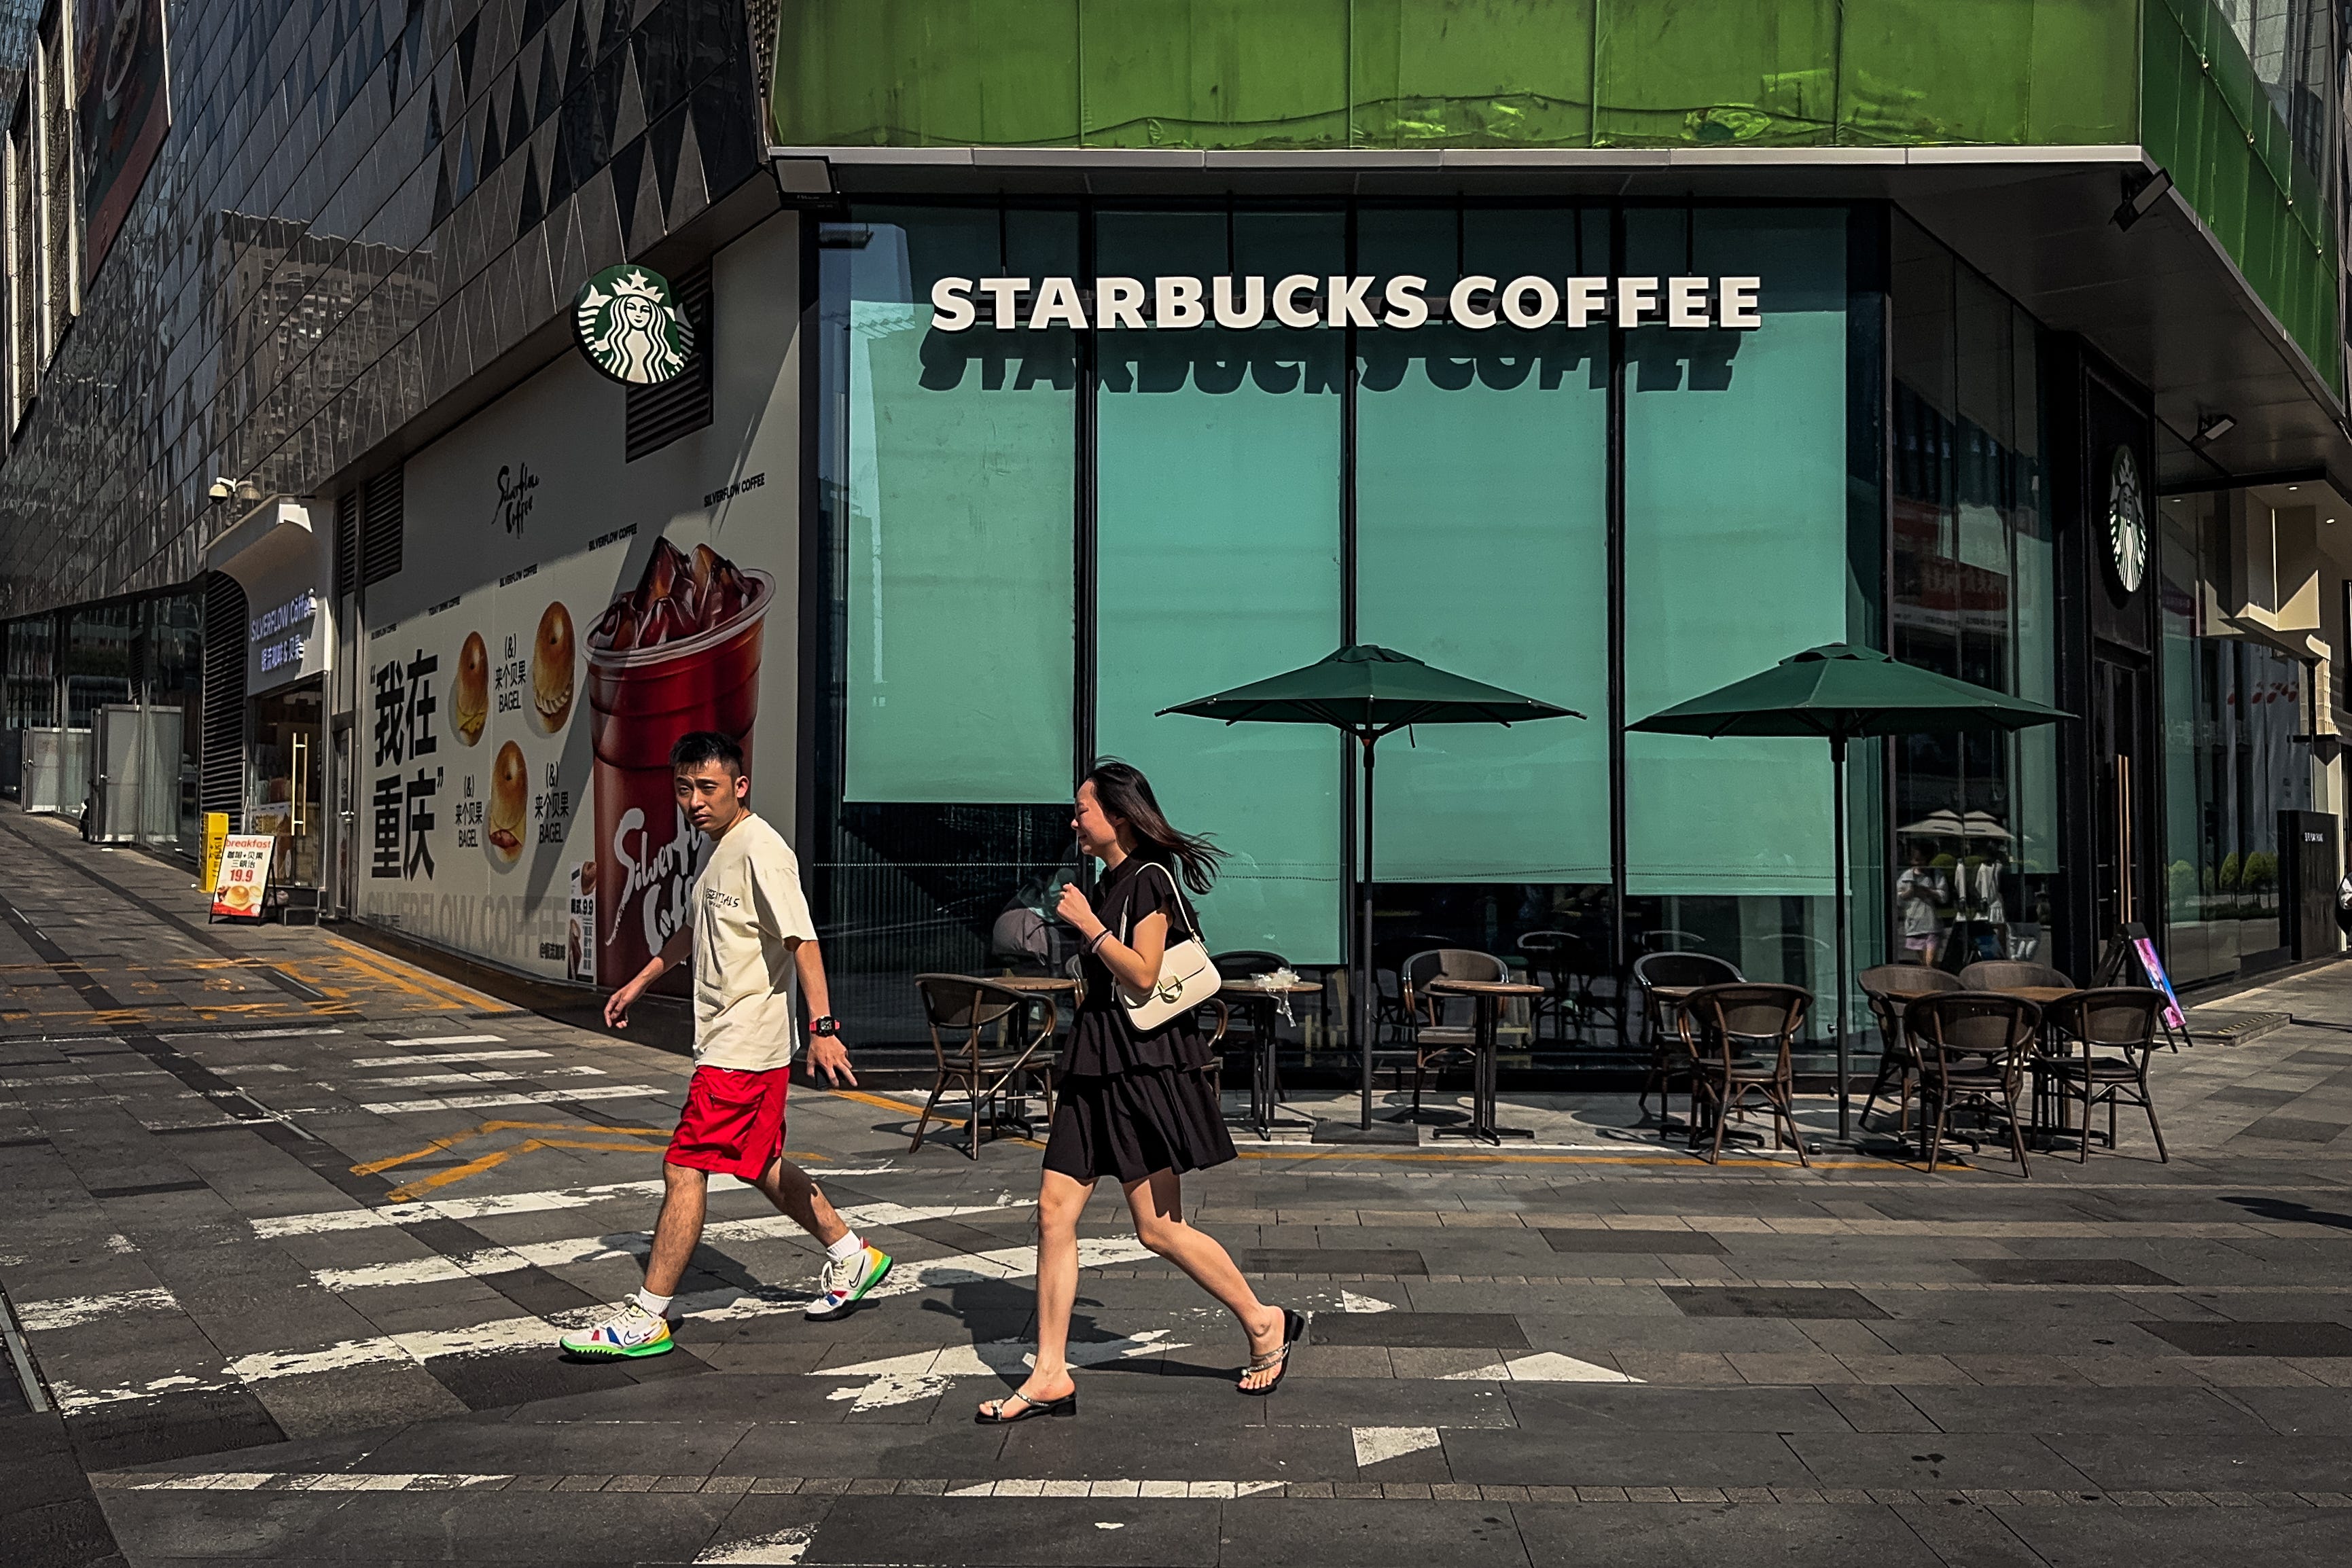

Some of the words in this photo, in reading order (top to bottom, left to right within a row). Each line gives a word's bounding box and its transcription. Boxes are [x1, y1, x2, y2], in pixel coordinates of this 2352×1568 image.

[930, 274, 1429, 330] STARBUCKS
[1449, 276, 1762, 330] COFFEE
[704, 482, 741, 508] SILVERFLOW
[741, 473, 765, 493] COFFEE
[618, 522, 637, 540] COFFEE
[251, 603, 289, 642] SILVERFLOW
[495, 660, 526, 691] 来个贝果
[498, 690, 522, 713] BAGEL
[455, 801, 483, 826] 来个贝果
[535, 791, 569, 819] 来个贝果
[226, 839, 271, 849] breakfast
[459, 829, 478, 849] BAGEL
[539, 822, 564, 844] BAGEL
[230, 869, 253, 882] 19.9
[605, 802, 705, 946] Silverf
